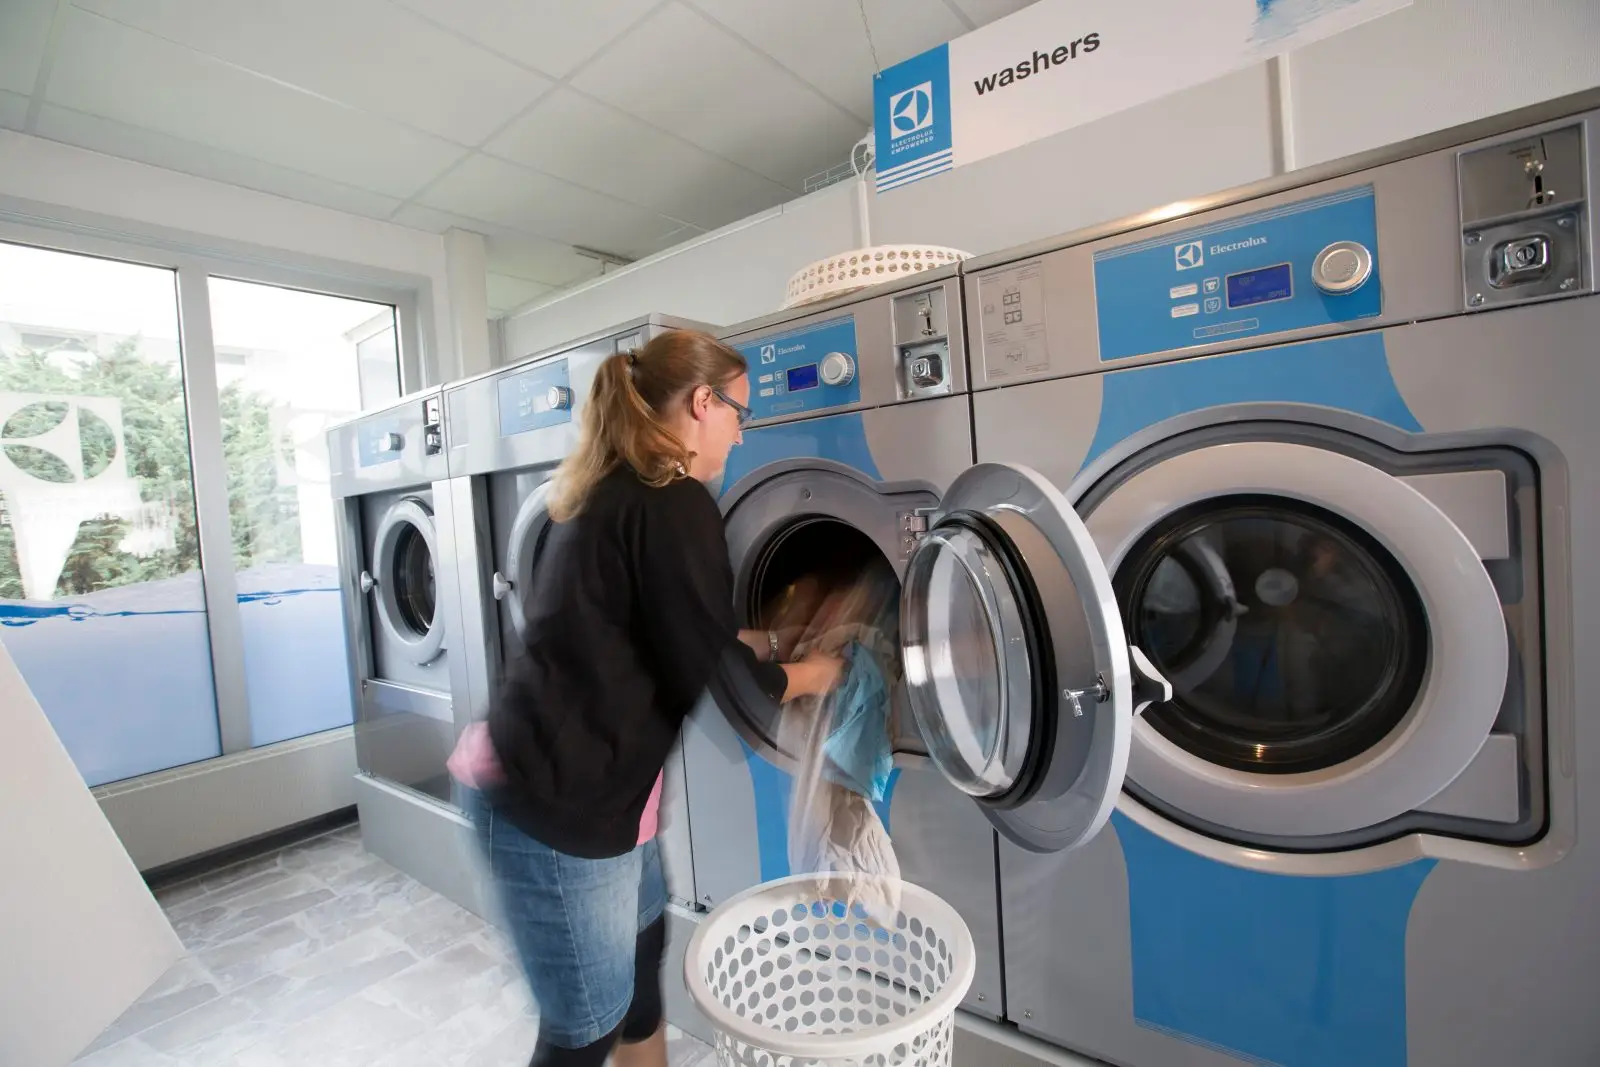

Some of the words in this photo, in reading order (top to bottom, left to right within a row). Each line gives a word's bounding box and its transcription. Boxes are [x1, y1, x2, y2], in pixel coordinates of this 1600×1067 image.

[974, 32, 1101, 96] washers
[891, 129, 933, 148] ELECTROLUX
[891, 135, 934, 155] EMPOWERED
[1210, 235, 1267, 256] Electrolux
